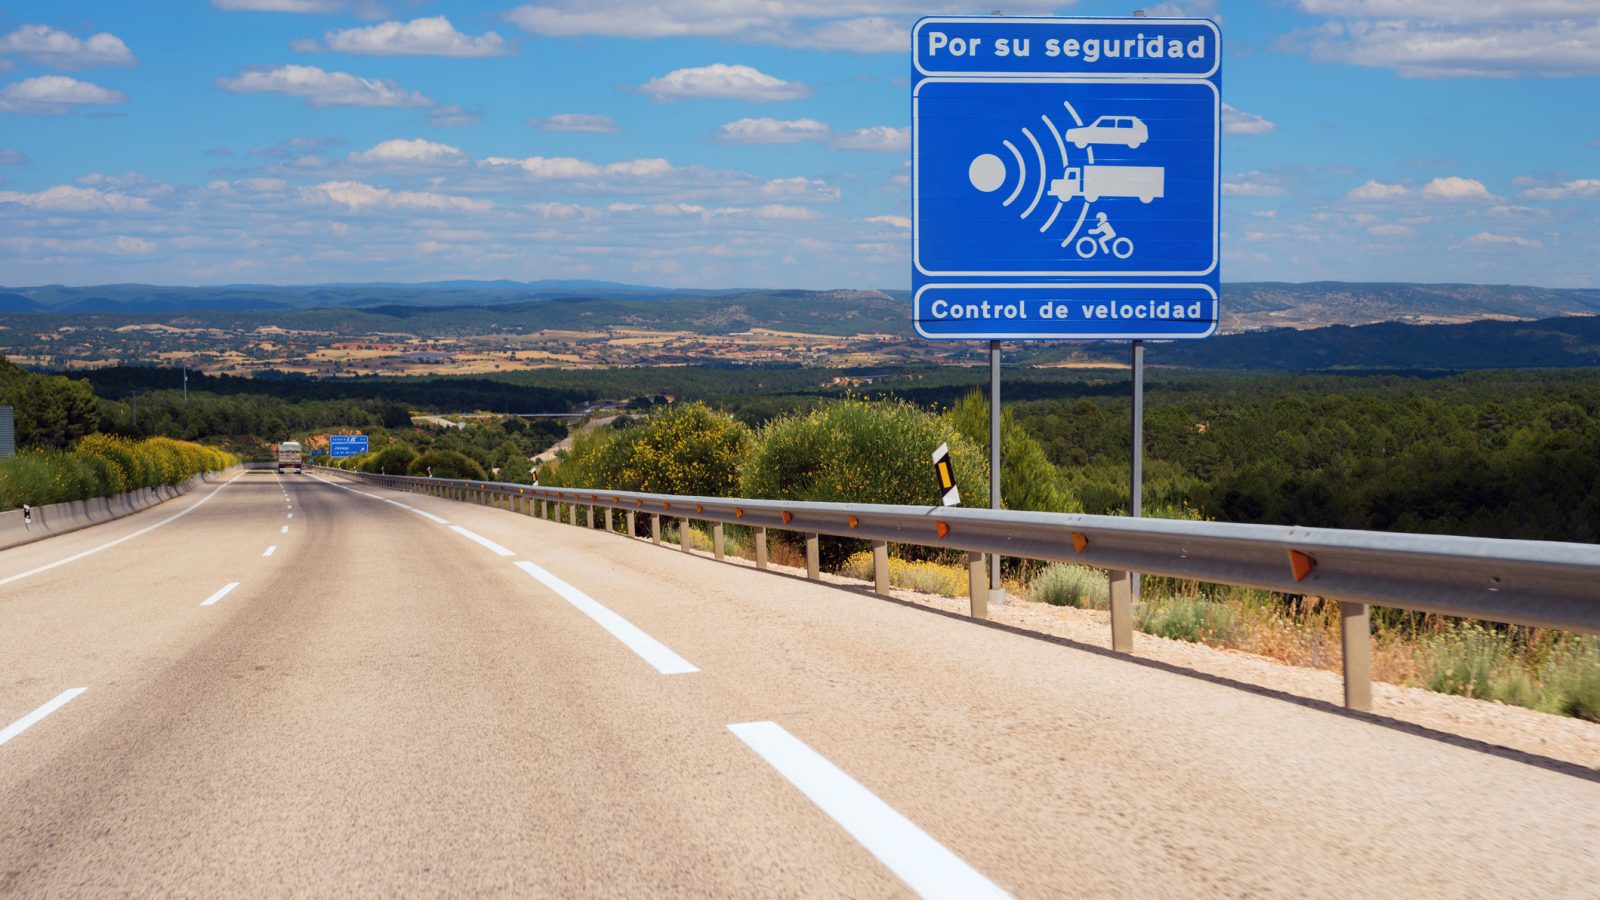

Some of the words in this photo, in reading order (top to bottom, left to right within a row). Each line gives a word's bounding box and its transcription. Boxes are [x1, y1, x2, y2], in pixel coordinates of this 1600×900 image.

[928, 31, 981, 57] Por
[994, 37, 1030, 58] su
[1045, 33, 1205, 61] seguridad
[931, 299, 1027, 319] Control
[1039, 300, 1069, 319] de
[1082, 300, 1201, 319] velocidad
